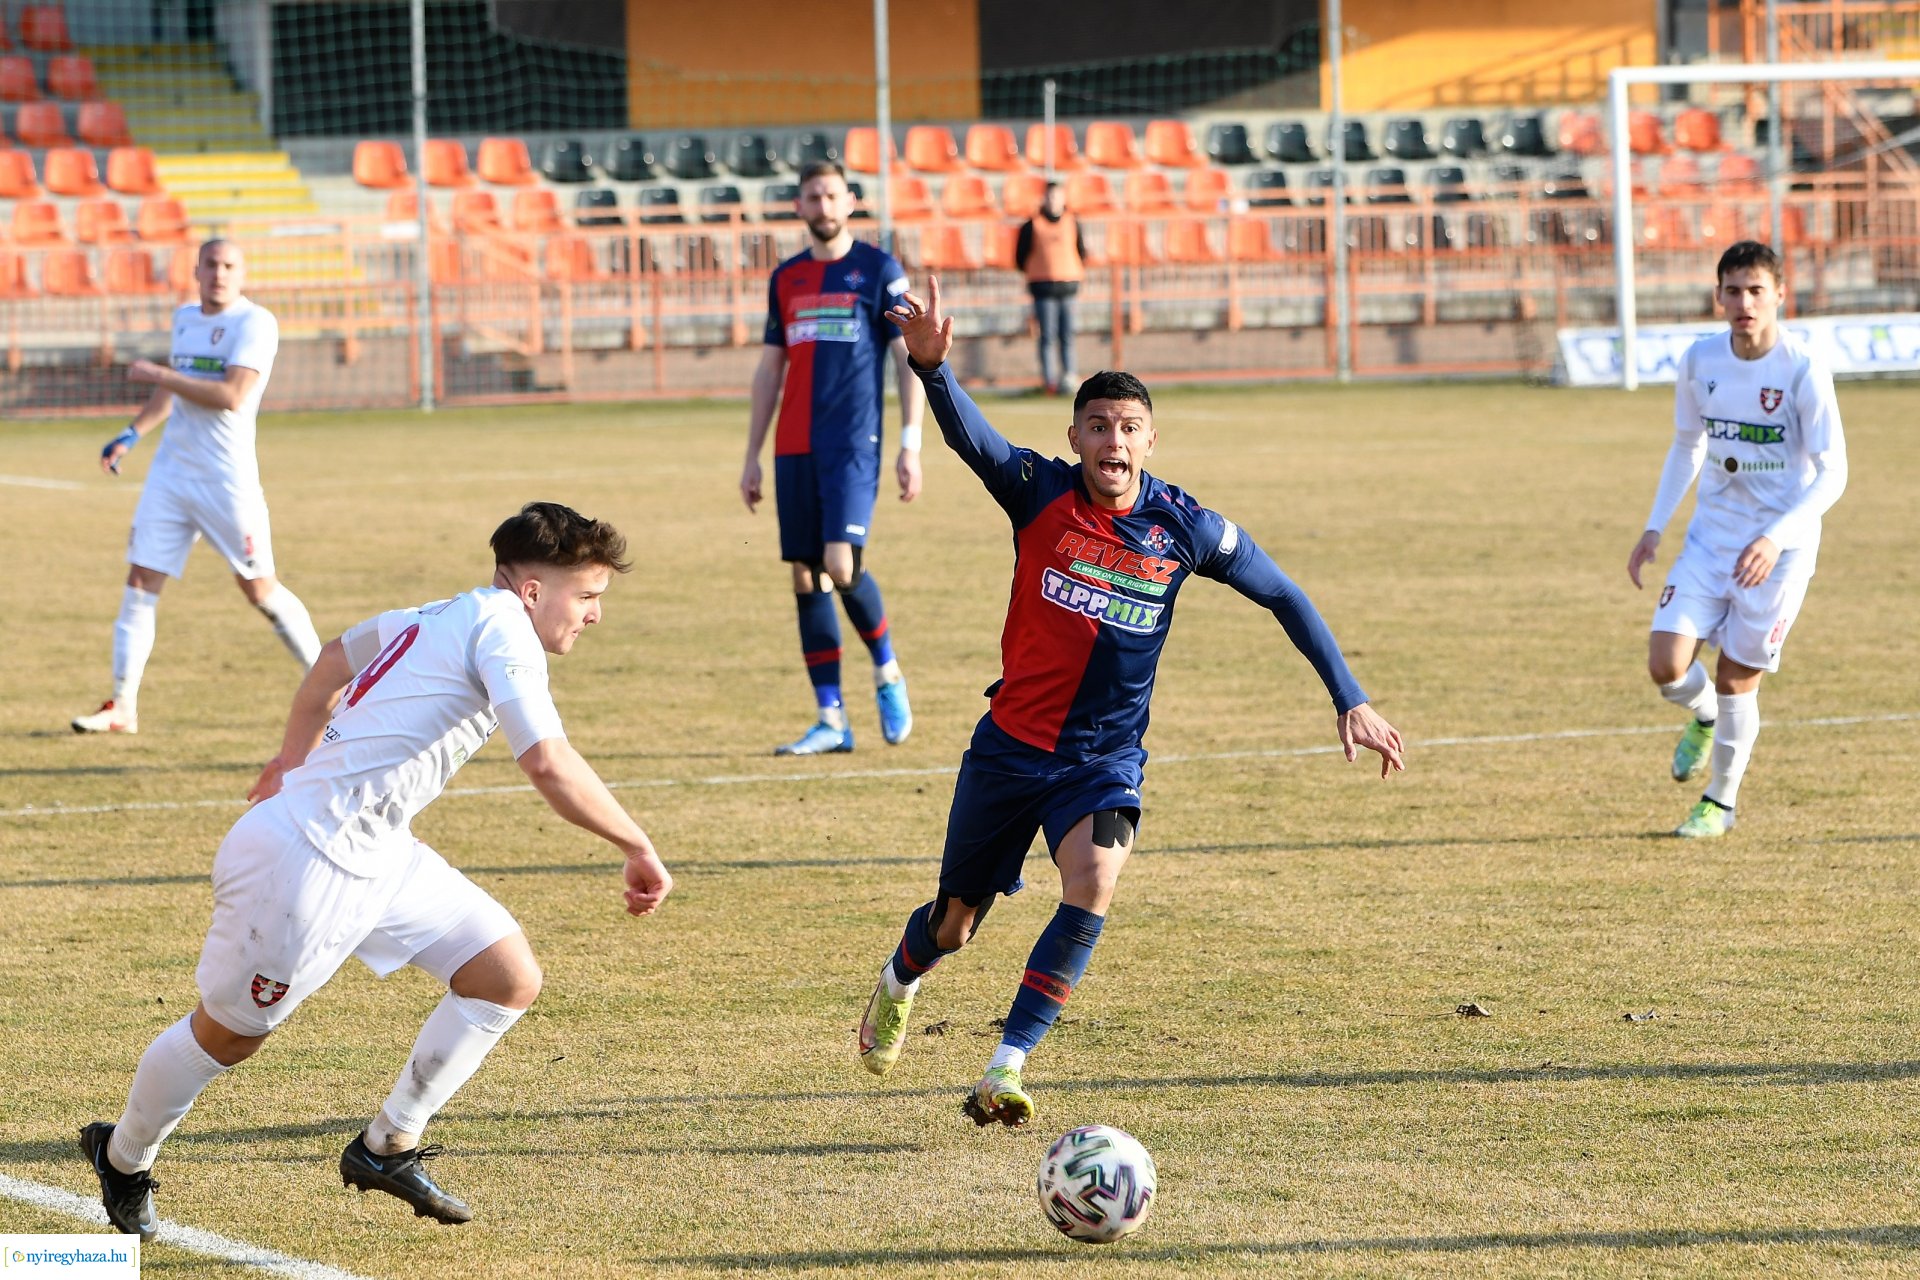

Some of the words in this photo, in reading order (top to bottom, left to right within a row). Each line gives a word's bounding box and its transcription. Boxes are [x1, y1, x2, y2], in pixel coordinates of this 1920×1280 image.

[1056, 531, 1180, 584] REVESZ
[1073, 563, 1101, 577] ALWAYS
[1102, 572, 1113, 580] ON
[1114, 575, 1127, 584] THE
[1127, 579, 1148, 591] RIGHT
[1148, 584, 1165, 594] WAY
